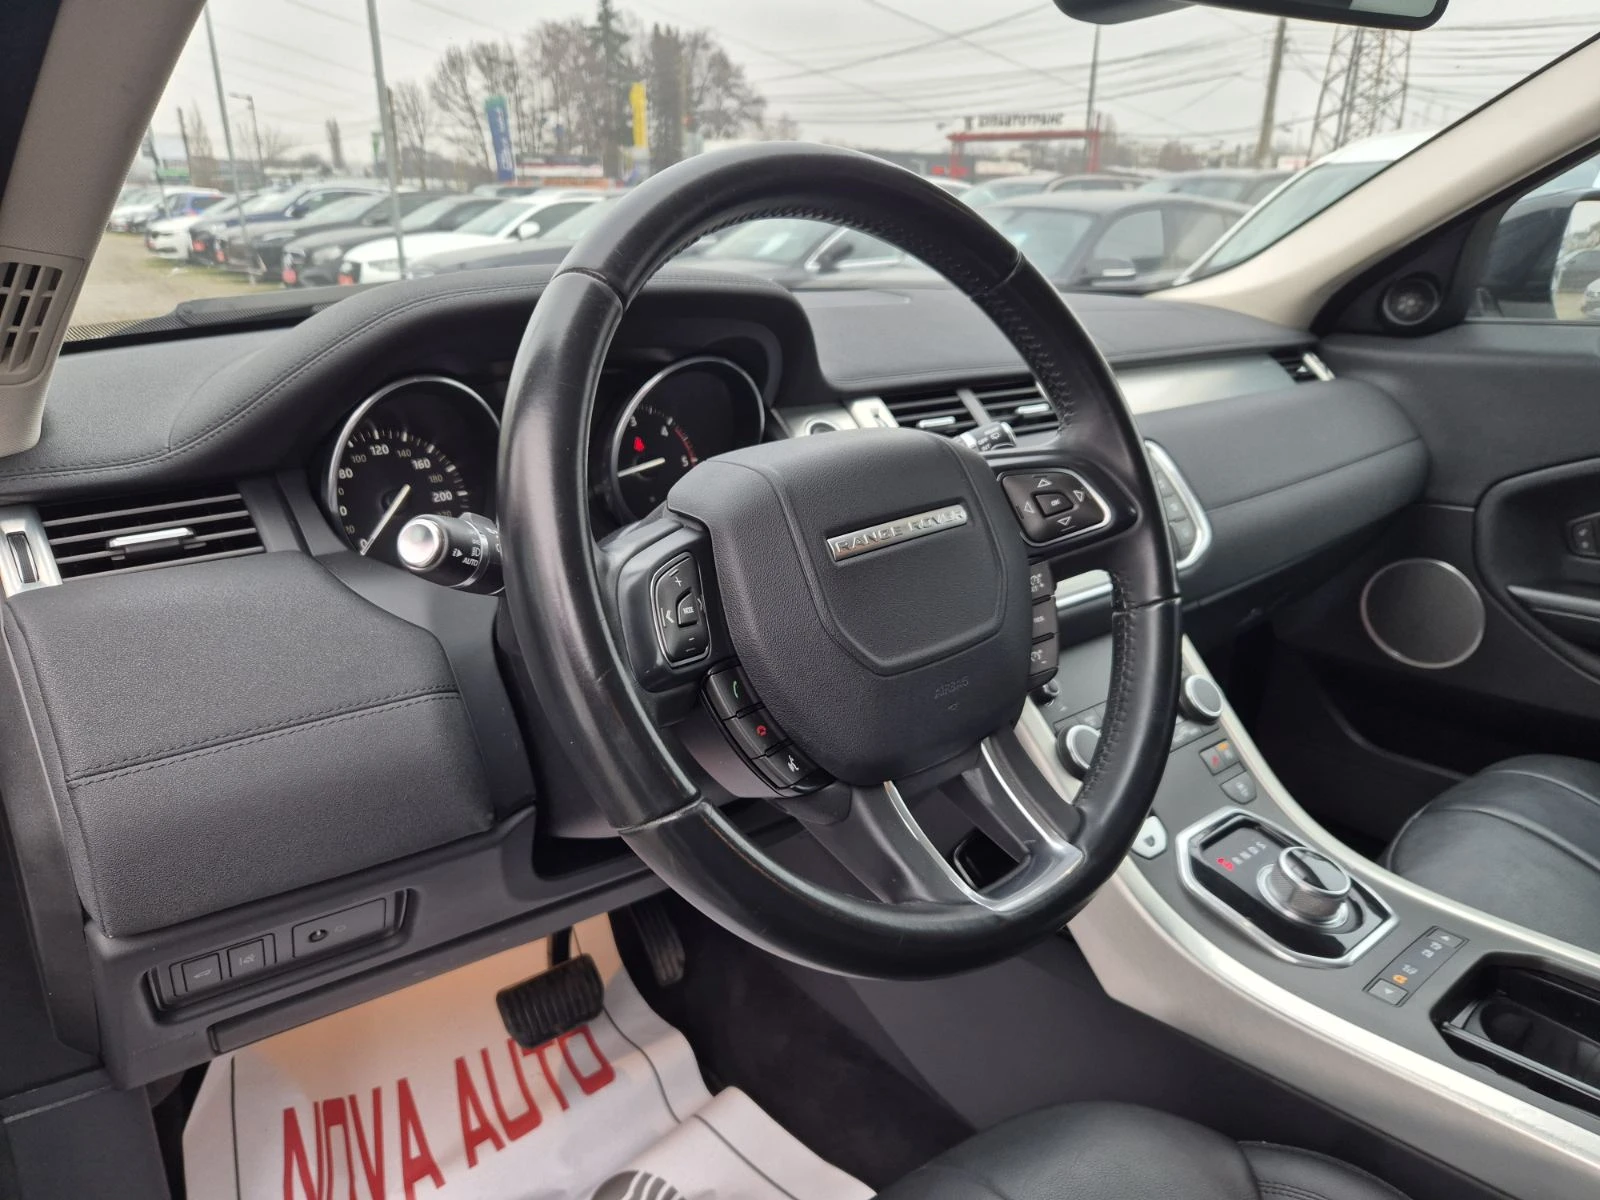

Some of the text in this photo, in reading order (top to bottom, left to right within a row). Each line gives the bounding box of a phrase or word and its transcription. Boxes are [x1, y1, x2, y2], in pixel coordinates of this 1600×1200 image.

[370, 444, 389, 456] 120
[397, 449, 412, 458] 140
[352, 454, 367, 463] 100
[412, 458, 431, 470] 160
[339, 467, 353, 479] 80
[429, 474, 443, 483] 180
[432, 491, 453, 502] 200
[834, 508, 966, 553] RANGE ROVER
[462, 556, 479, 567] AUTO
[283, 1025, 616, 1200] NOVA AUTO
